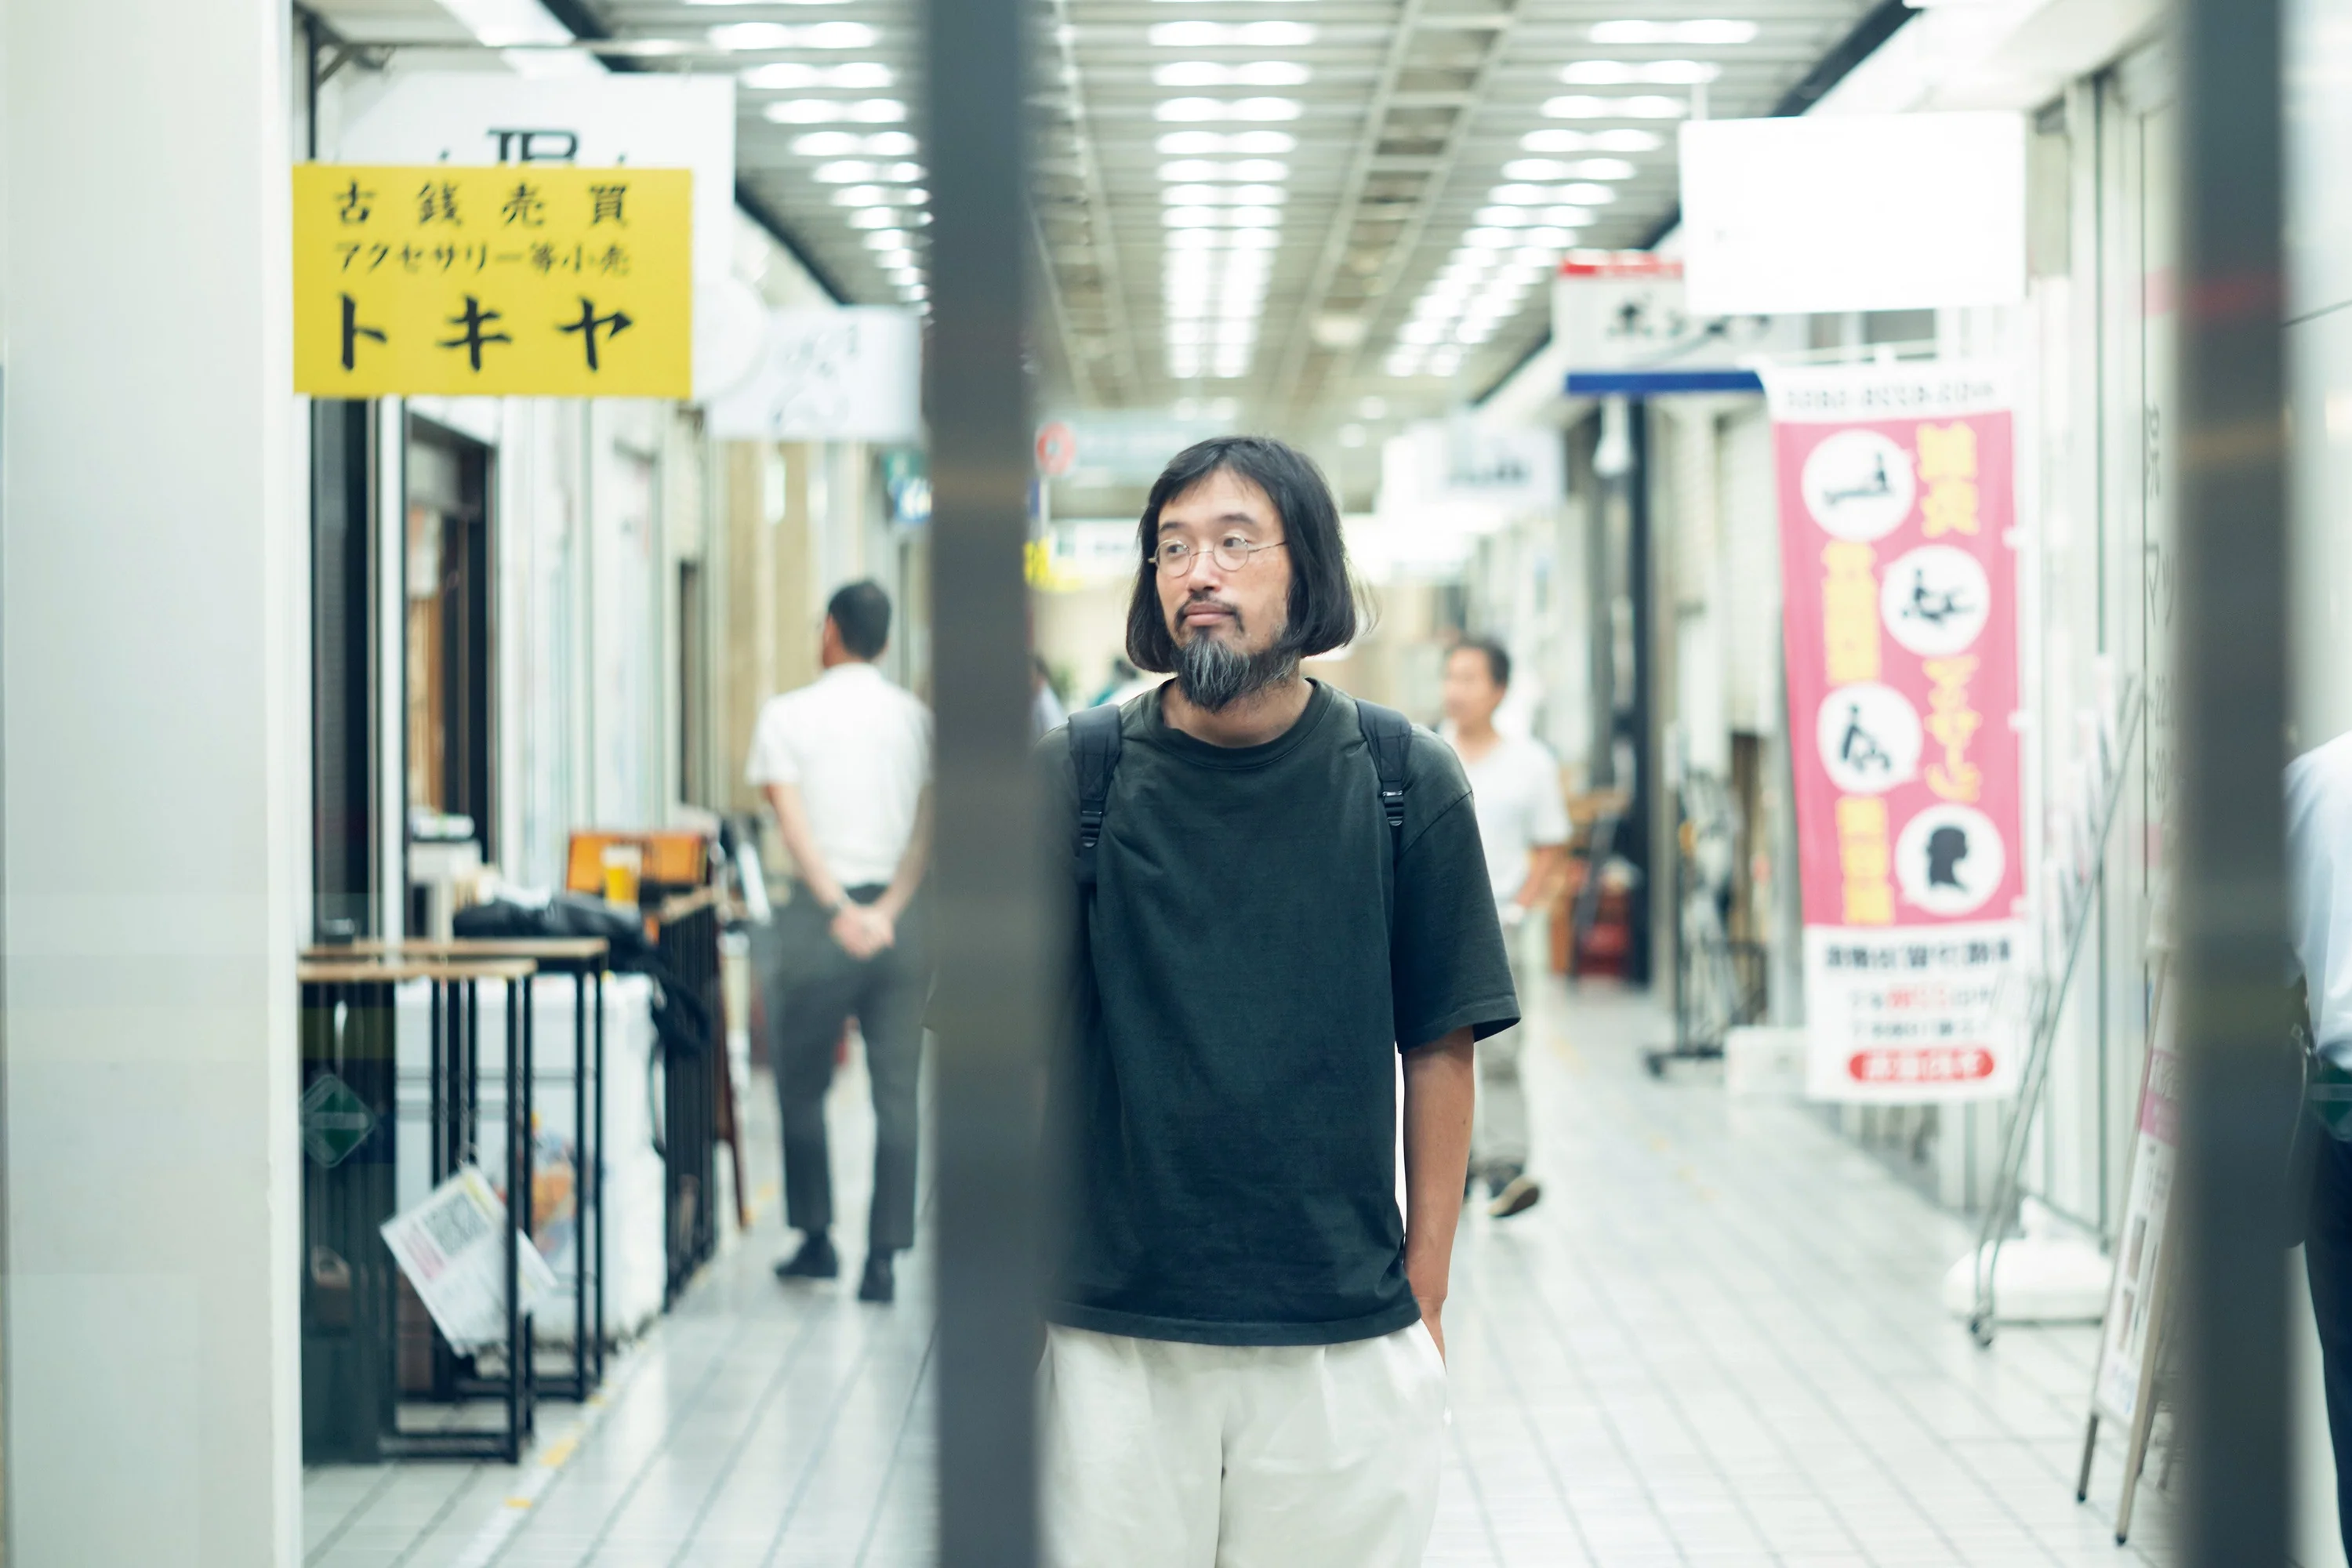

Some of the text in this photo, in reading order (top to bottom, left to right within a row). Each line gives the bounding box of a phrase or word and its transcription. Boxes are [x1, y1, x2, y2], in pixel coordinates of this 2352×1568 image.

[337, 241, 630, 274] アクセサリー等小売
[338, 291, 633, 374] トキヤ
